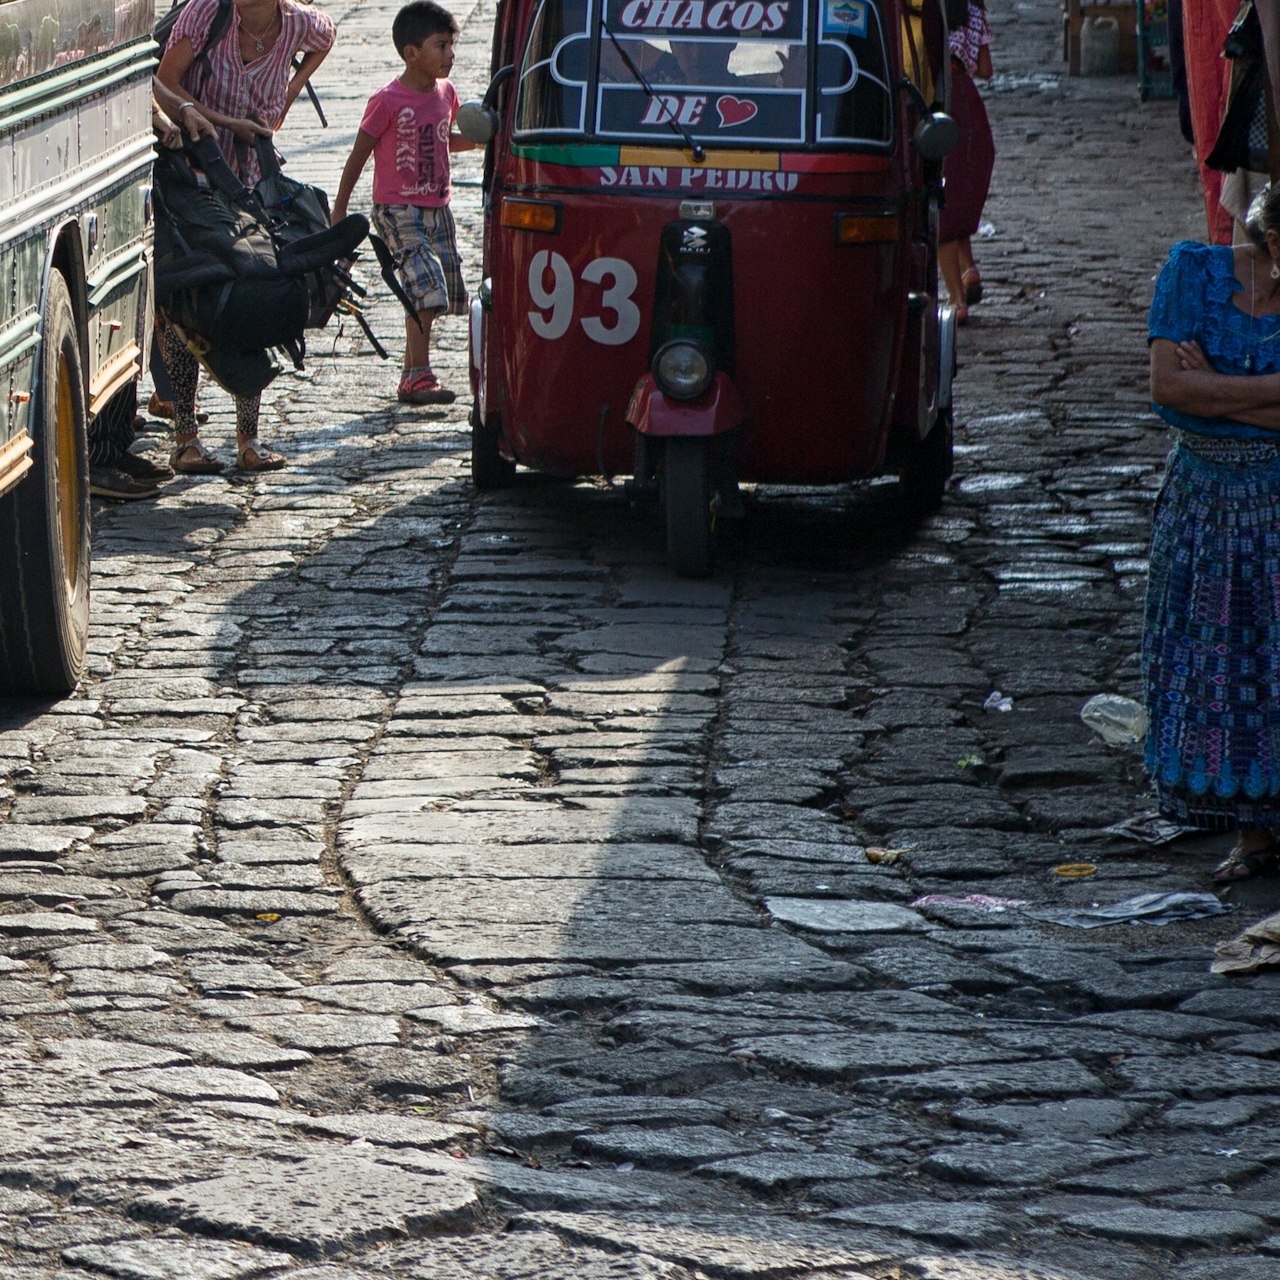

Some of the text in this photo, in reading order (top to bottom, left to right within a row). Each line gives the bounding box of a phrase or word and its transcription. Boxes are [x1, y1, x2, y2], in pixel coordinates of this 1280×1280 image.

[640, 94, 708, 127] DE
[598, 164, 801, 193] SAN PEDRO
[527, 249, 642, 346] 93
